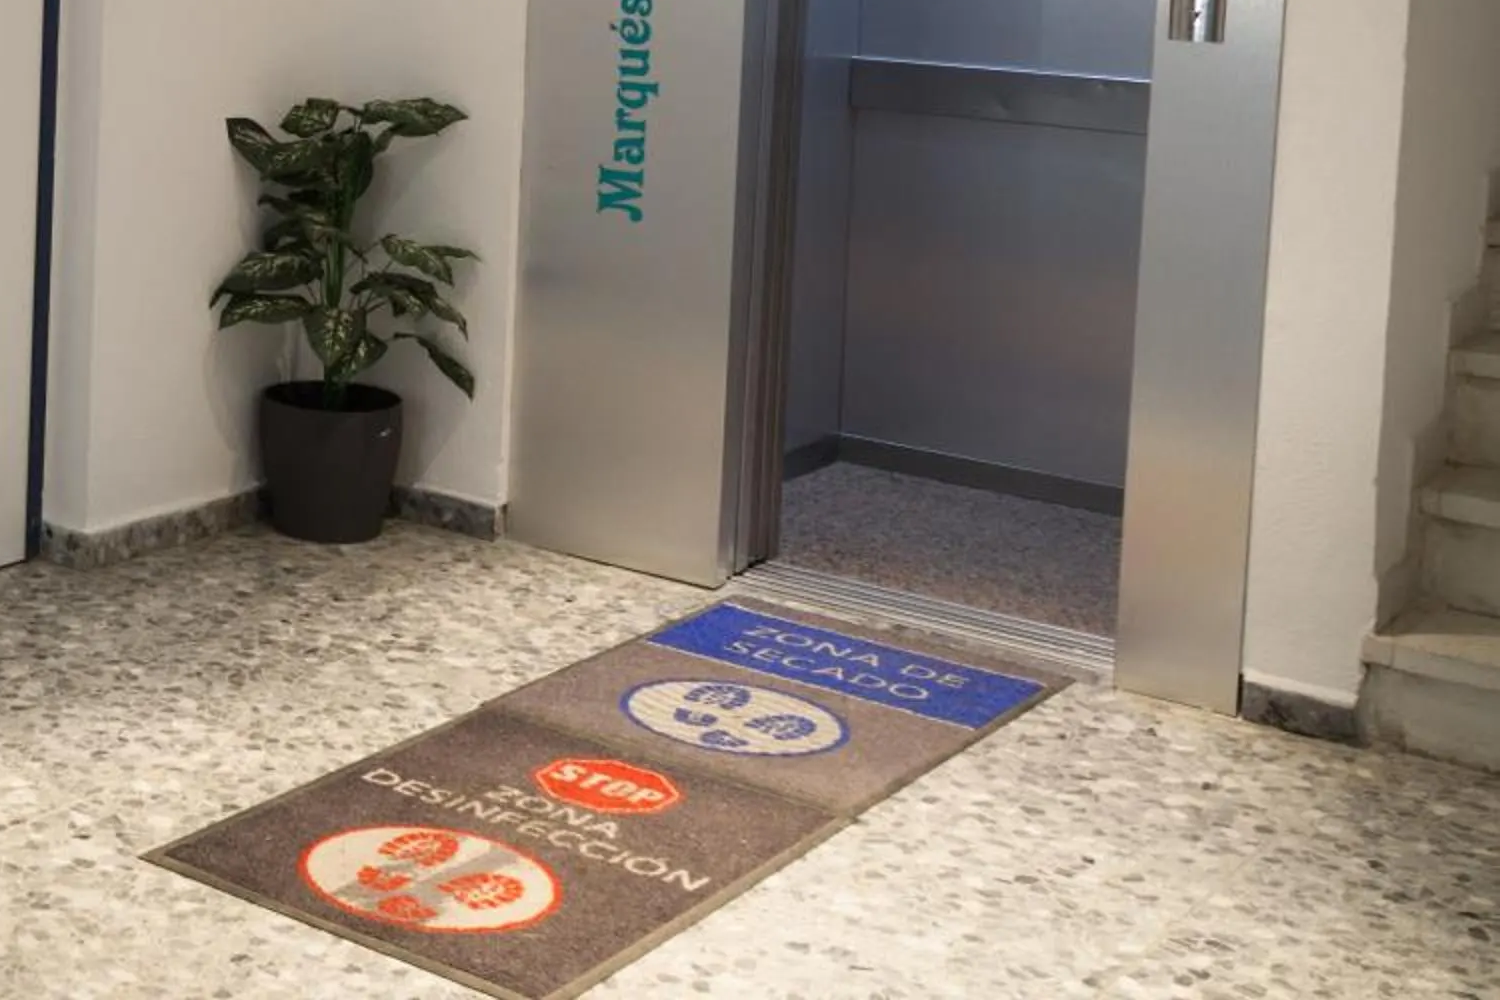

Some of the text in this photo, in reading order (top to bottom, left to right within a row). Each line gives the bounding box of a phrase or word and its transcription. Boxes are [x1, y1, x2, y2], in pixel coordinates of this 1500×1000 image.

[723, 640, 929, 700] SECADO
[742, 625, 971, 690] ZONA DE
[485, 785, 619, 840] ZONA
[553, 762, 665, 804] STOP
[361, 767, 712, 892] DESINFECCIÓN
